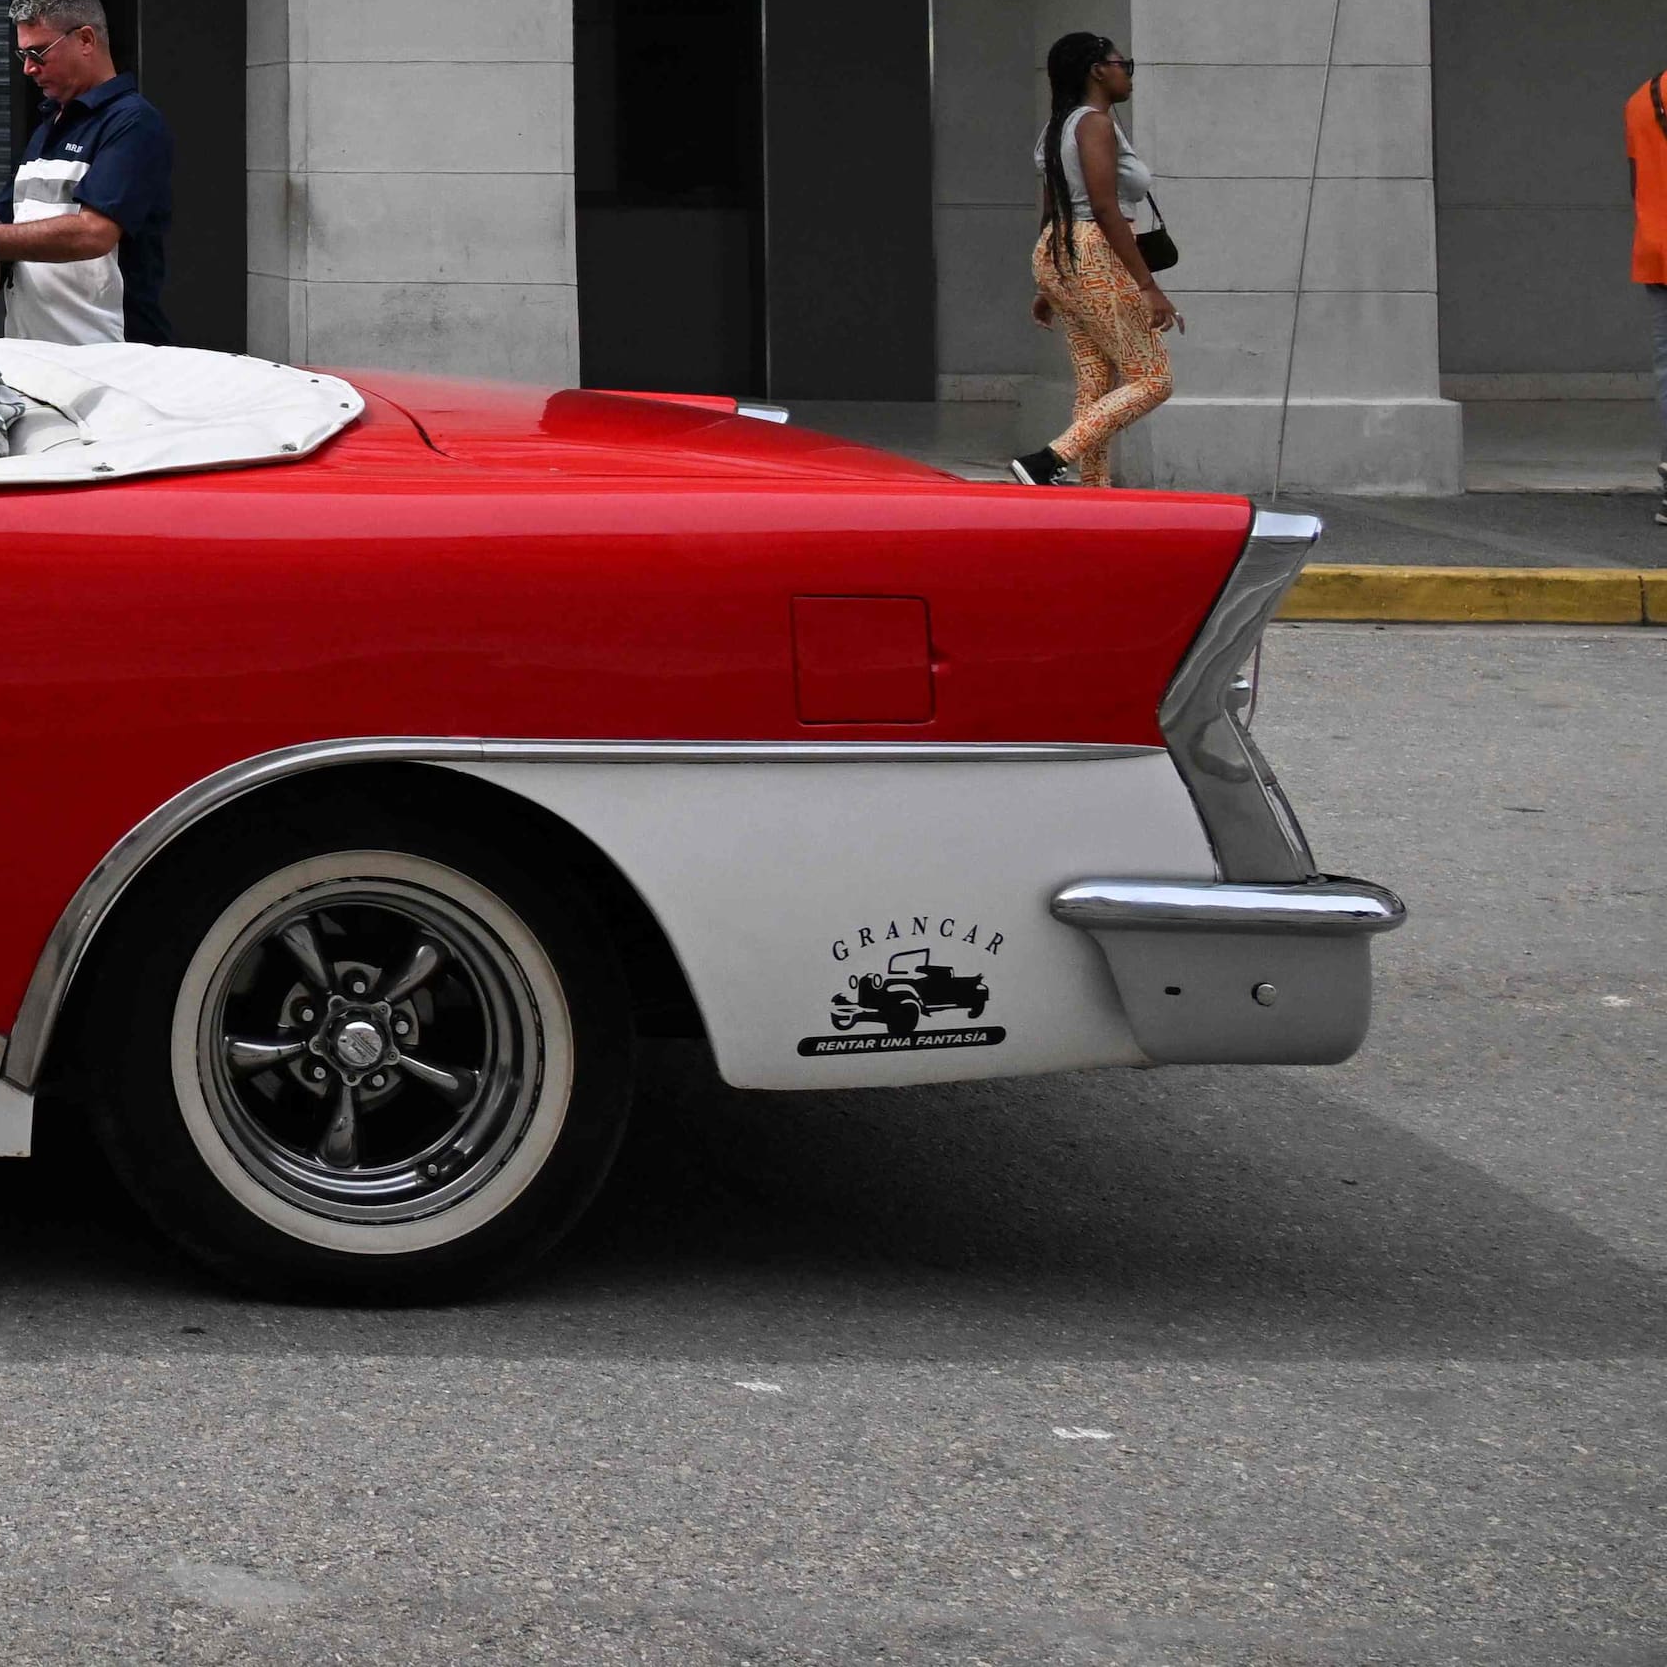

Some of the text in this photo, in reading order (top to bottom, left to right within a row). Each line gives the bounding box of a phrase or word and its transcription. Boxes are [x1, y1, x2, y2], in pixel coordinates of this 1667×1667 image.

[832, 916, 1004, 961] GRANCAR
[815, 1039, 875, 1052] RENTAR
[880, 1037, 911, 1048] UNA
